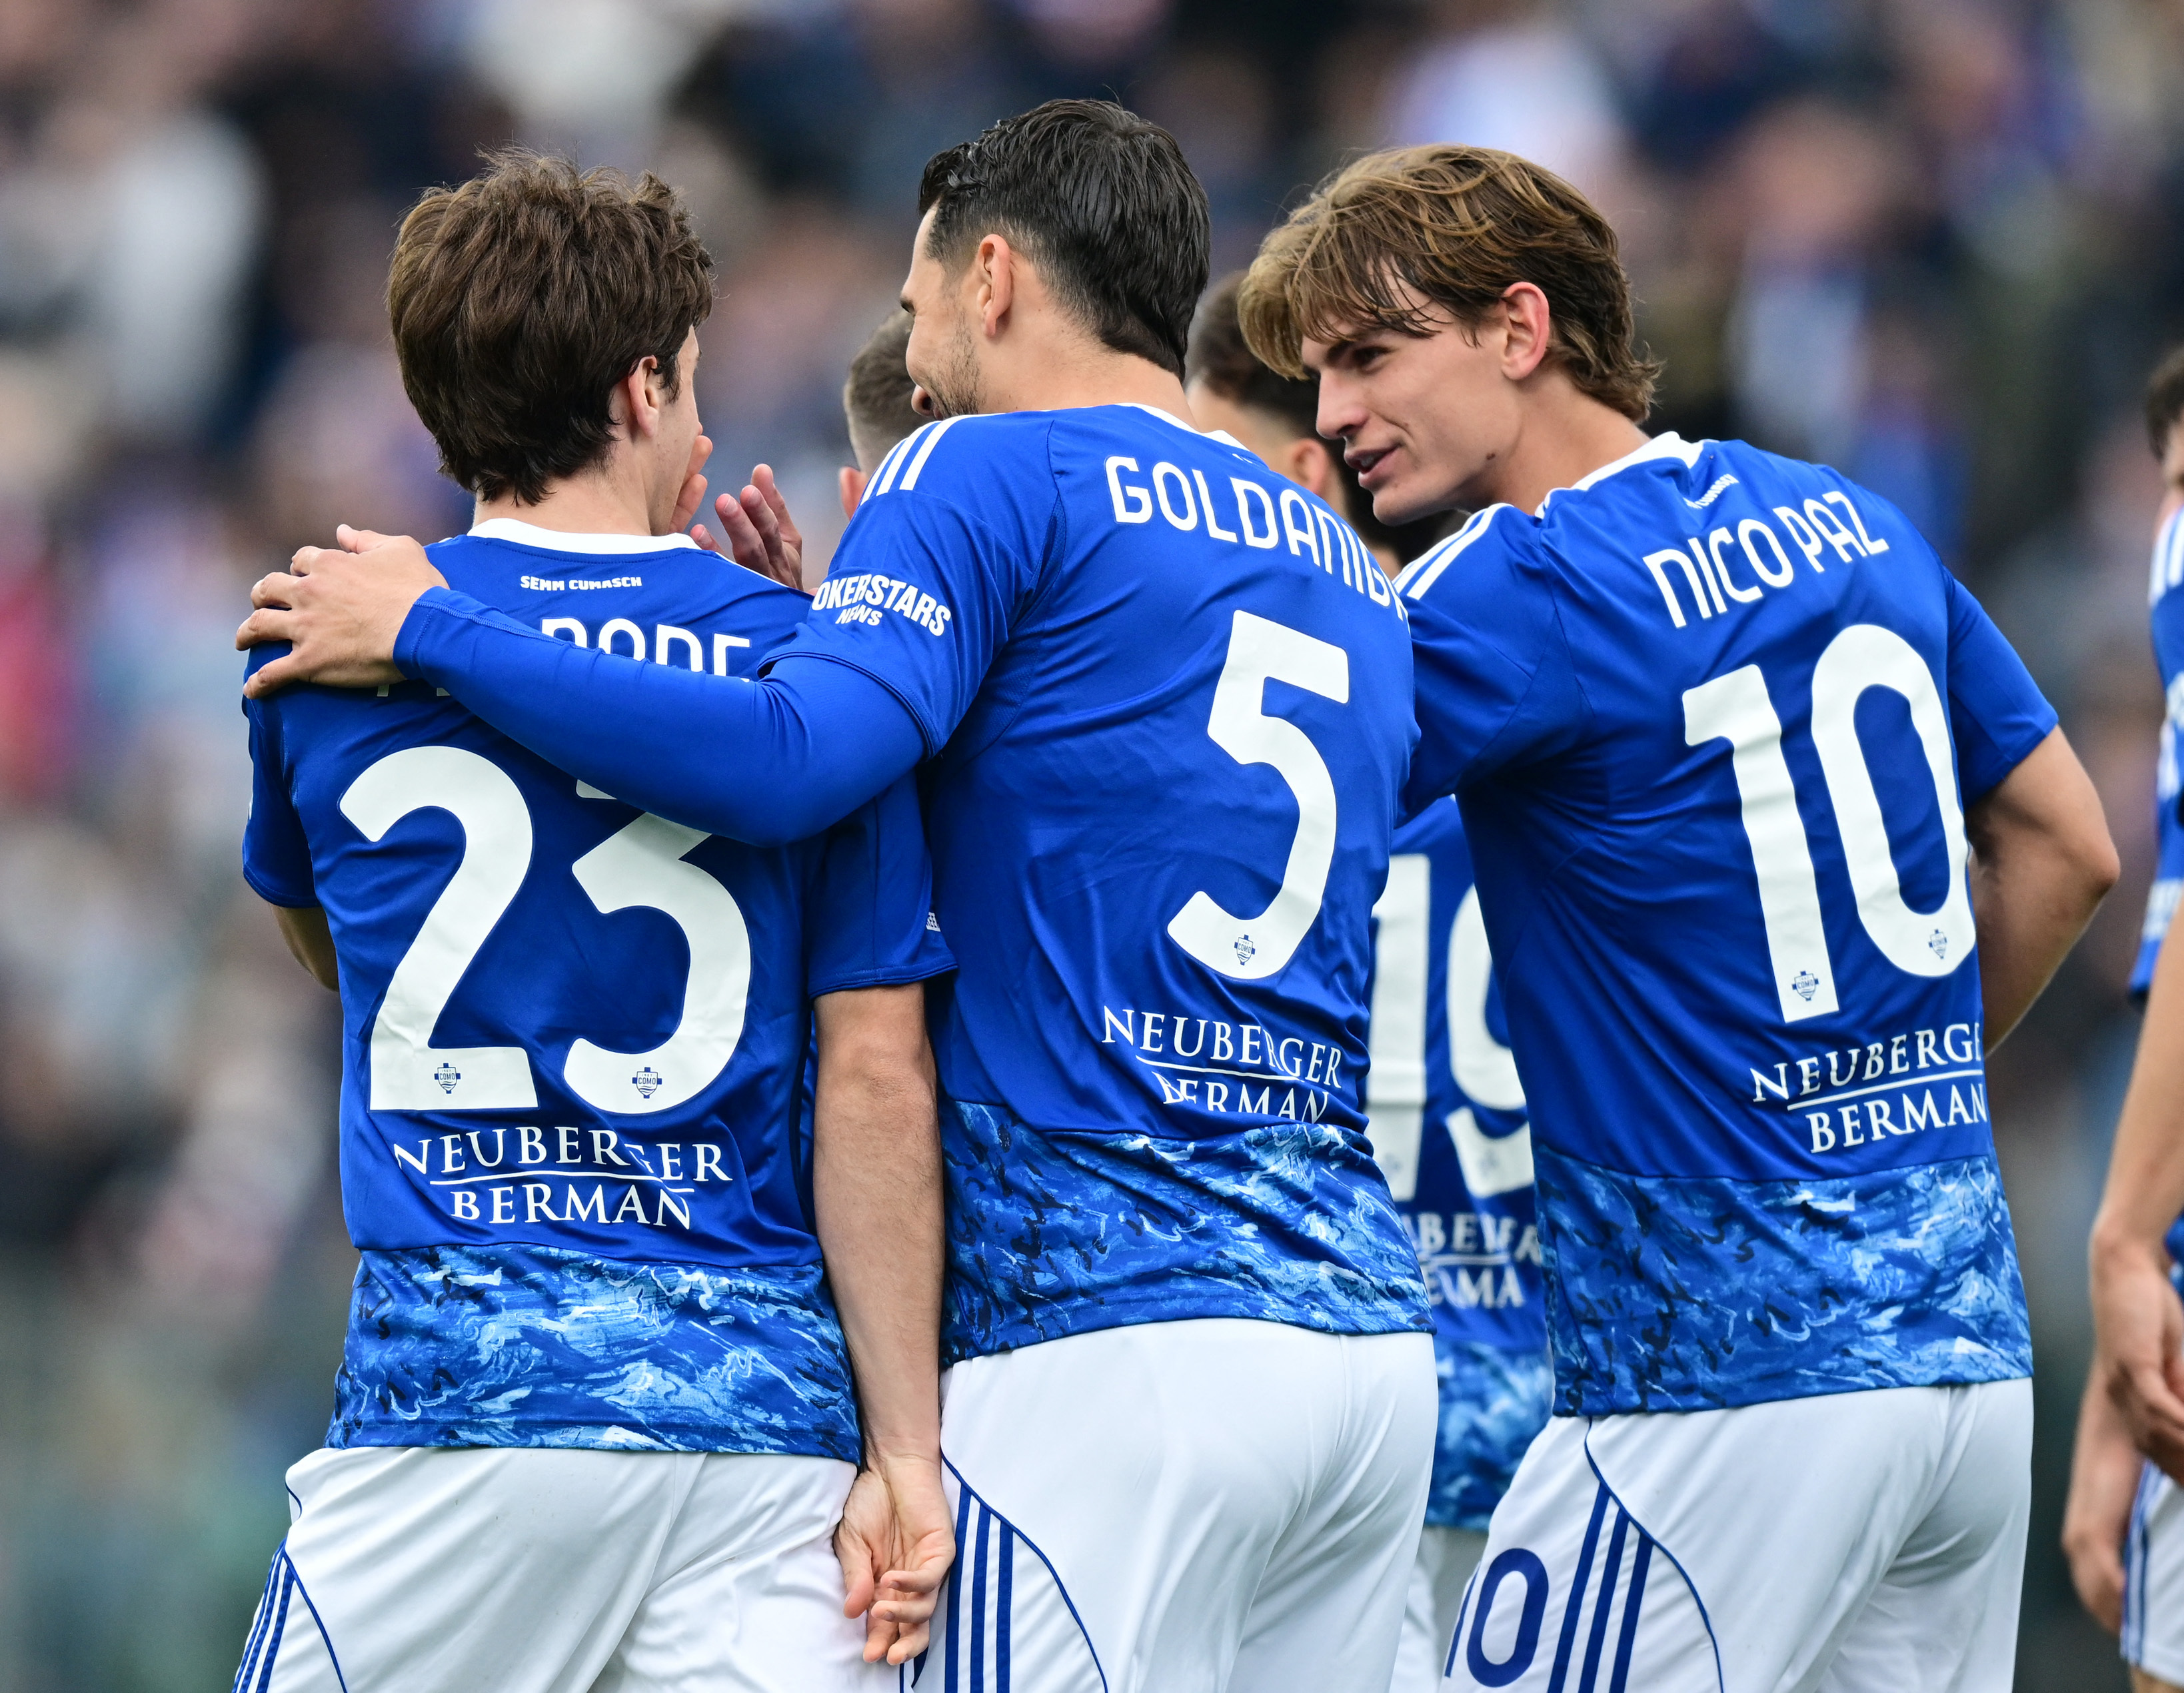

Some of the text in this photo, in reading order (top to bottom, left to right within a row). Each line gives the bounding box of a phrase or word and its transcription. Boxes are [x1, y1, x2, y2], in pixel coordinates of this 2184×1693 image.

[520, 575, 642, 592] SEMM CUMASCH
[1642, 491, 1890, 628] NICO PAZ
[811, 574, 952, 636] OKERSTARS
[835, 604, 883, 626] NEWS
[1167, 609, 1350, 980] 5
[1681, 624, 1977, 1023] 10
[338, 744, 752, 1115] 23
[1101, 1005, 1342, 1089] NEUBERGER
[1749, 1021, 1982, 1103] NEUBERGE
[1805, 1083, 1988, 1154] BERMAN
[450, 1183, 690, 1230] BERMAN
